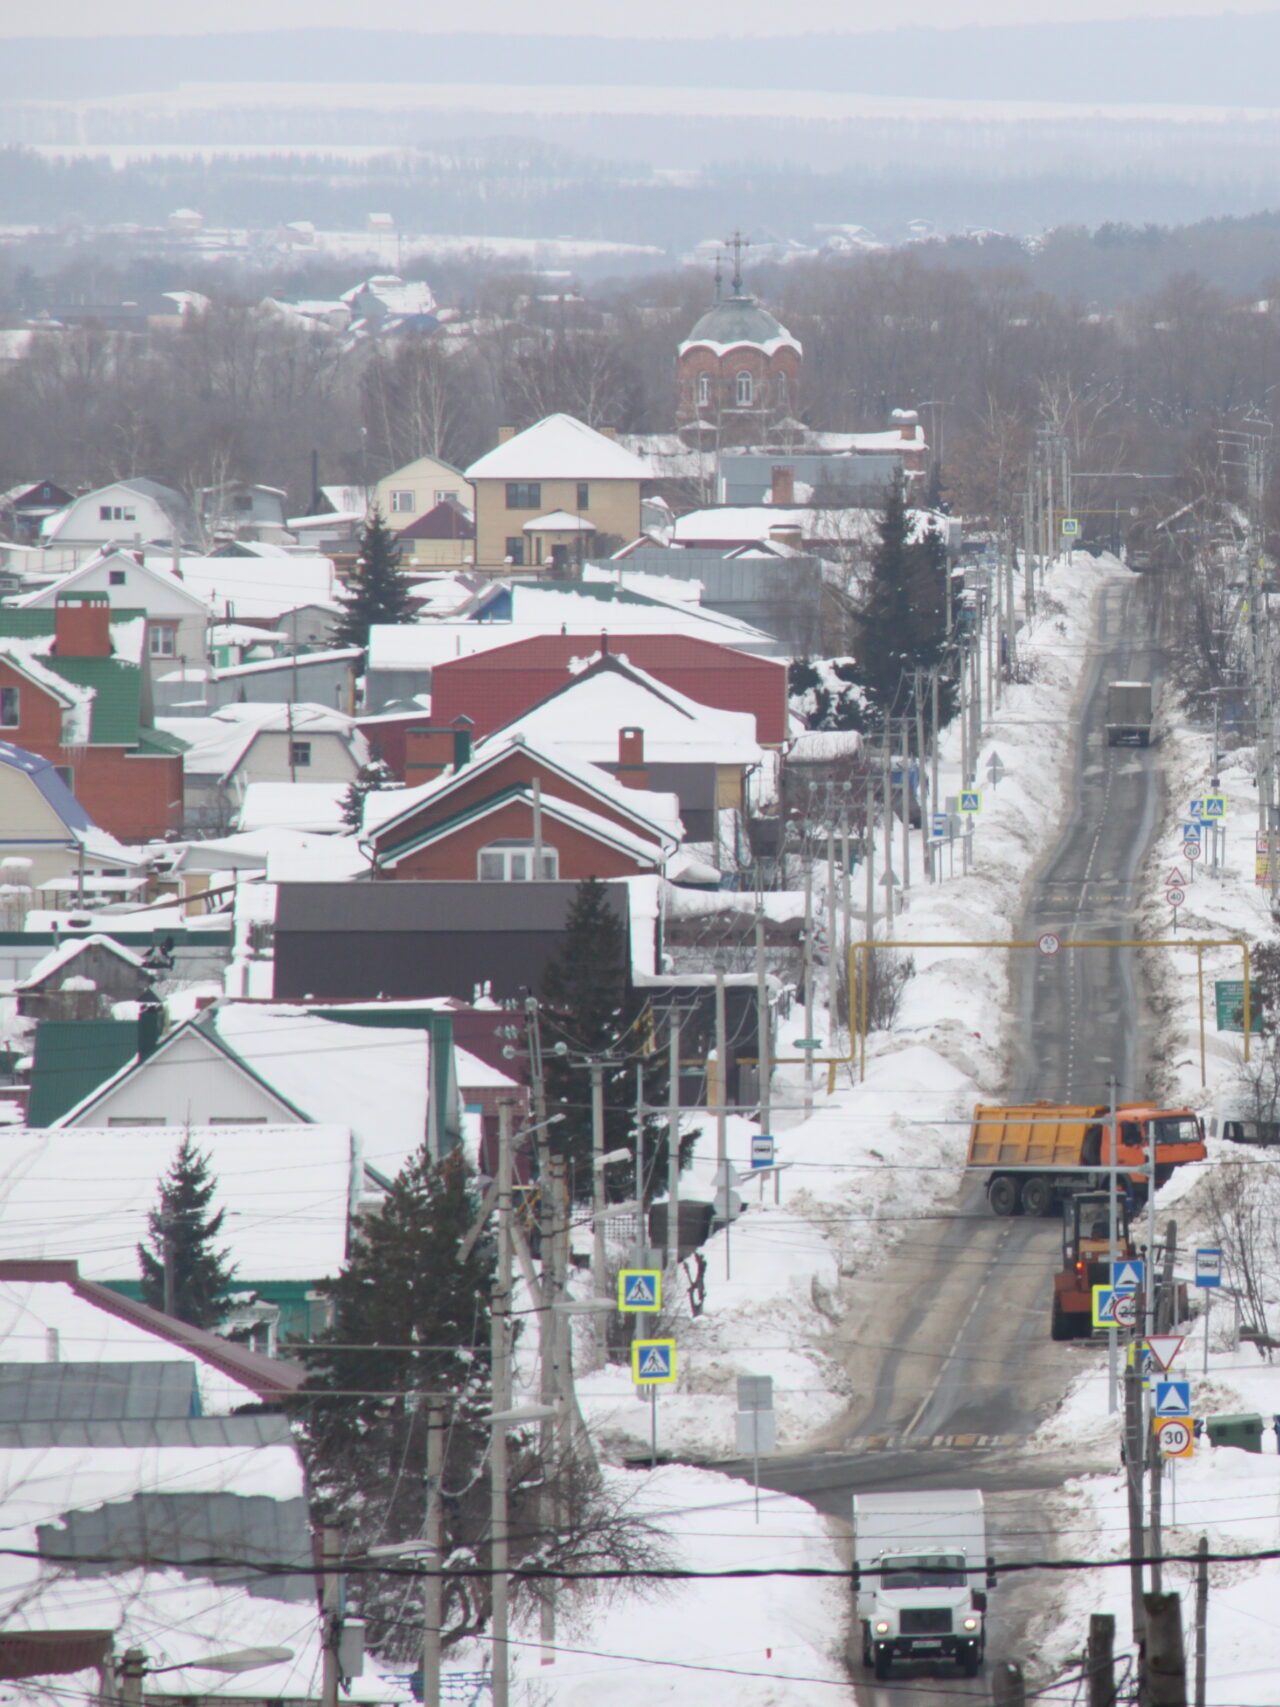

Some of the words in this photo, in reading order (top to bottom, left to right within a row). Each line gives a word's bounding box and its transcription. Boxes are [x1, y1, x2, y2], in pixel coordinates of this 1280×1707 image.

[1187, 847, 1198, 856] 20
[1170, 892, 1181, 902] 40
[1164, 1431, 1183, 1445] 30
